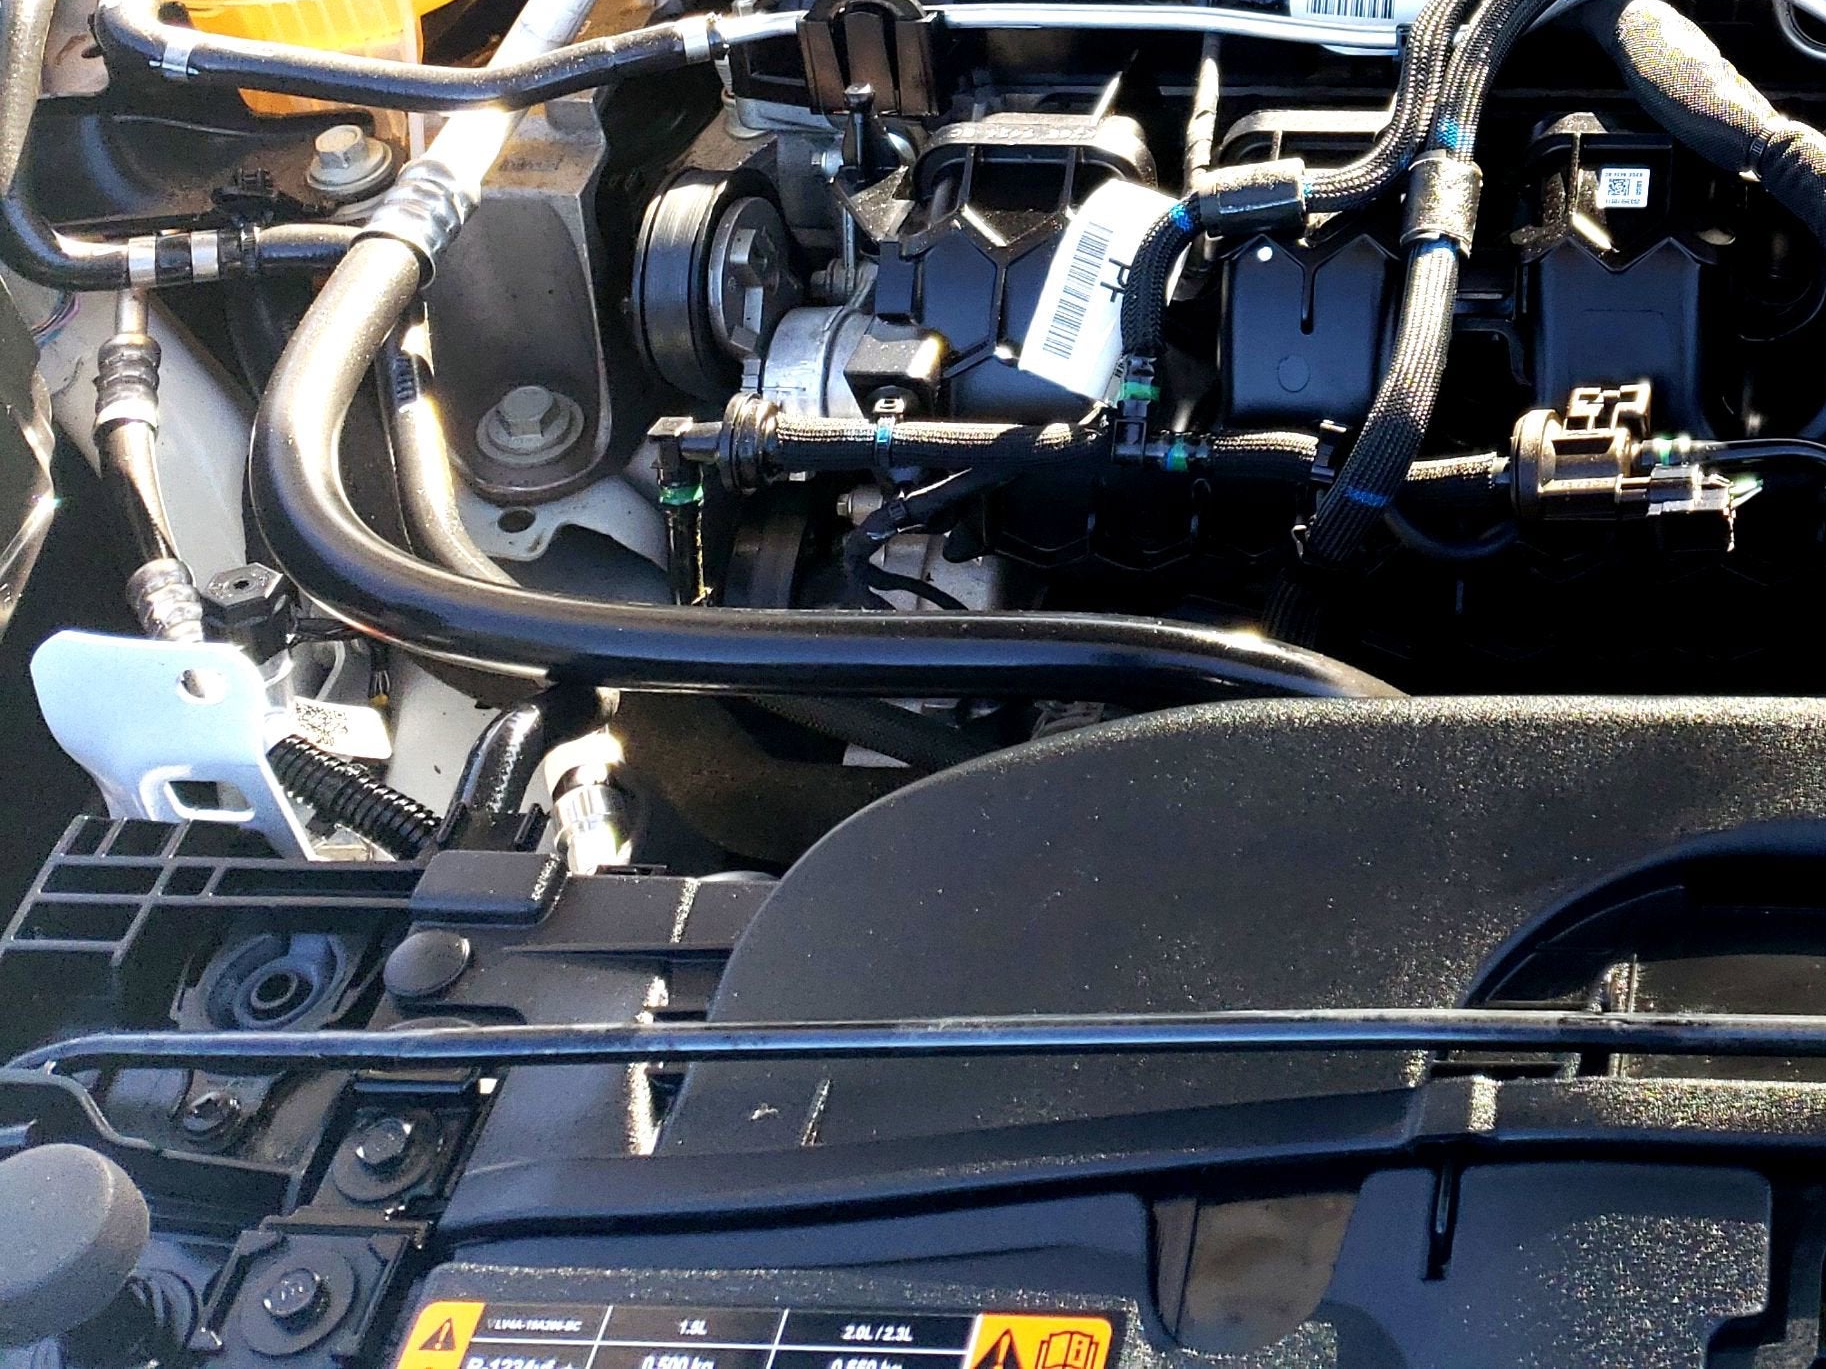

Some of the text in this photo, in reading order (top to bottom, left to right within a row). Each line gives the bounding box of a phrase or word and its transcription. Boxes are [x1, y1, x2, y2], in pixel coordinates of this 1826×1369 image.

[679, 1319, 708, 1336] 1.5L
[842, 1325, 873, 1341] 2.0L
[641, 1355, 690, 1369] 0500
